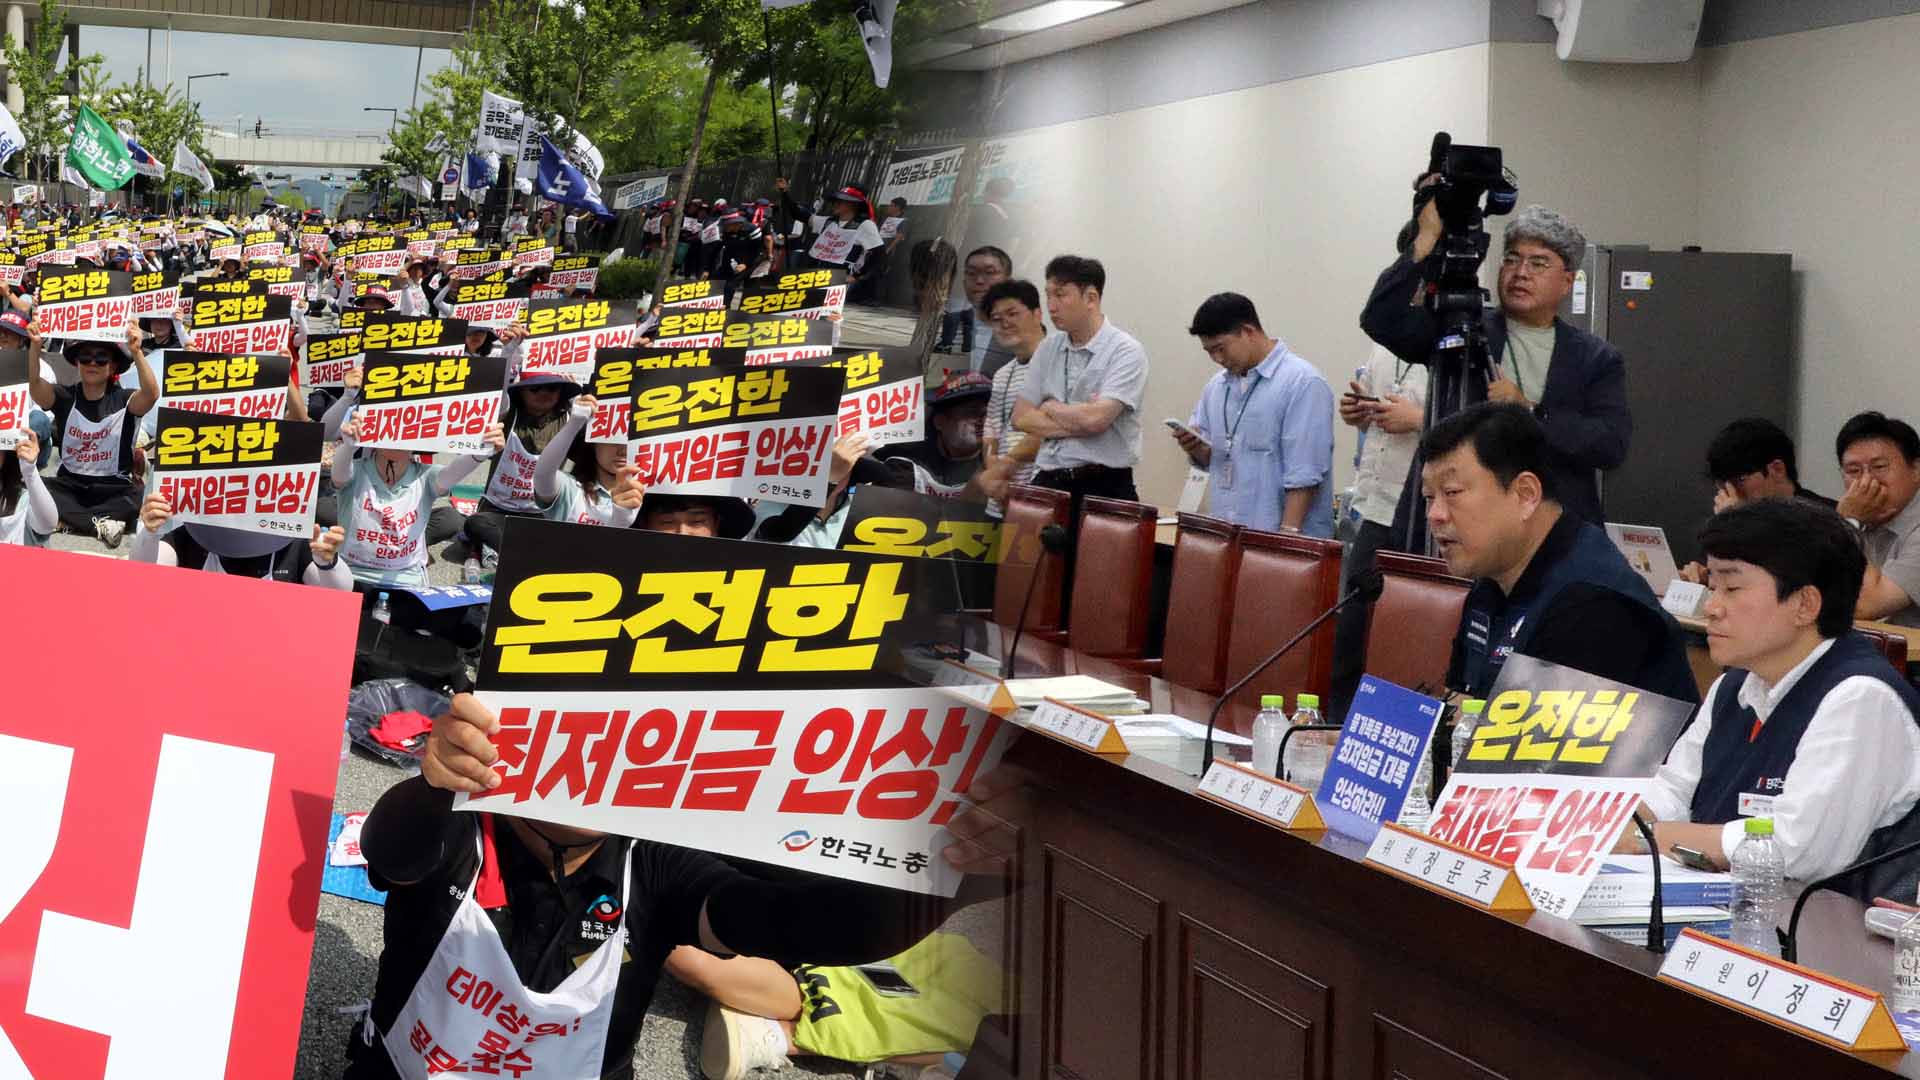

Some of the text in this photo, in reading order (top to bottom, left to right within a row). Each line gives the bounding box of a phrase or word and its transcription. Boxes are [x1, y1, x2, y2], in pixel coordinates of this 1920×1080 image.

[73, 131, 131, 179] 화학노련
[888, 156, 953, 186] 저임금노동자
[245, 231, 276, 245] 온전한
[337, 244, 355, 257] 온전
[356, 237, 395, 253] 온전한
[445, 238, 476, 250] 온전한
[517, 239, 546, 252] 온전한
[354, 250, 404, 270] 최저임금 인상!
[458, 250, 491, 264] 온전한
[553, 257, 588, 271] 온전한
[40, 272, 110, 301] 온전한
[131, 271, 163, 292] 전한
[249, 266, 293, 283] 온전한
[551, 271, 578, 285] 최저임금
[777, 269, 832, 290] 온전한
[156, 289, 178, 309] 인상!
[457, 283, 508, 303] 온전한
[663, 280, 711, 302] 온전한
[740, 291, 806, 314] 온전한
[40, 303, 94, 333] 최저임금
[96, 300, 130, 327] 인상!
[194, 295, 267, 326] 온전한
[454, 301, 520, 322] 최저임금 인상!
[529, 300, 612, 336] 온전한
[658, 310, 727, 337] 온전한
[194, 323, 288, 353] 최저임금 인상!
[309, 333, 361, 362] 온전한
[363, 319, 444, 350] 온전한
[723, 319, 809, 348] 온전한
[526, 334, 590, 369] 최저임금
[164, 356, 259, 393] 온전한
[364, 357, 471, 400] 온전한
[0, 390, 27, 429] 상!
[633, 369, 790, 433] 온전한
[866, 383, 921, 429] 인상!
[360, 397, 499, 443] 최저임금 인상!
[158, 421, 280, 465] 온전한
[884, 430, 914, 441] 한국노총
[631, 424, 832, 488] 최저임금 인상!
[159, 471, 317, 515] 최저임금 인상!
[501, 474, 532, 490] 공무원보
[771, 484, 812, 499] 한국노총
[357, 528, 408, 546] 공무원보수
[1623, 532, 1664, 545] NEWSIS
[494, 562, 909, 673] 온전한
[1349, 712, 1420, 758] 물가폭등 못살겠다!
[1467, 689, 1640, 764] 온전한
[469, 706, 998, 826] 최저임금 인상!
[1337, 736, 1411, 790] 최저임금 대폭
[1330, 777, 1387, 824] 인상하라!!
[1428, 785, 1640, 876] 최저임금 인상!
[820, 835, 930, 875] 한국노총
[1423, 849, 1492, 894] 정문주
[1531, 886, 1567, 915] 한국노총
[1684, 951, 1852, 1031] 위원 이정희
